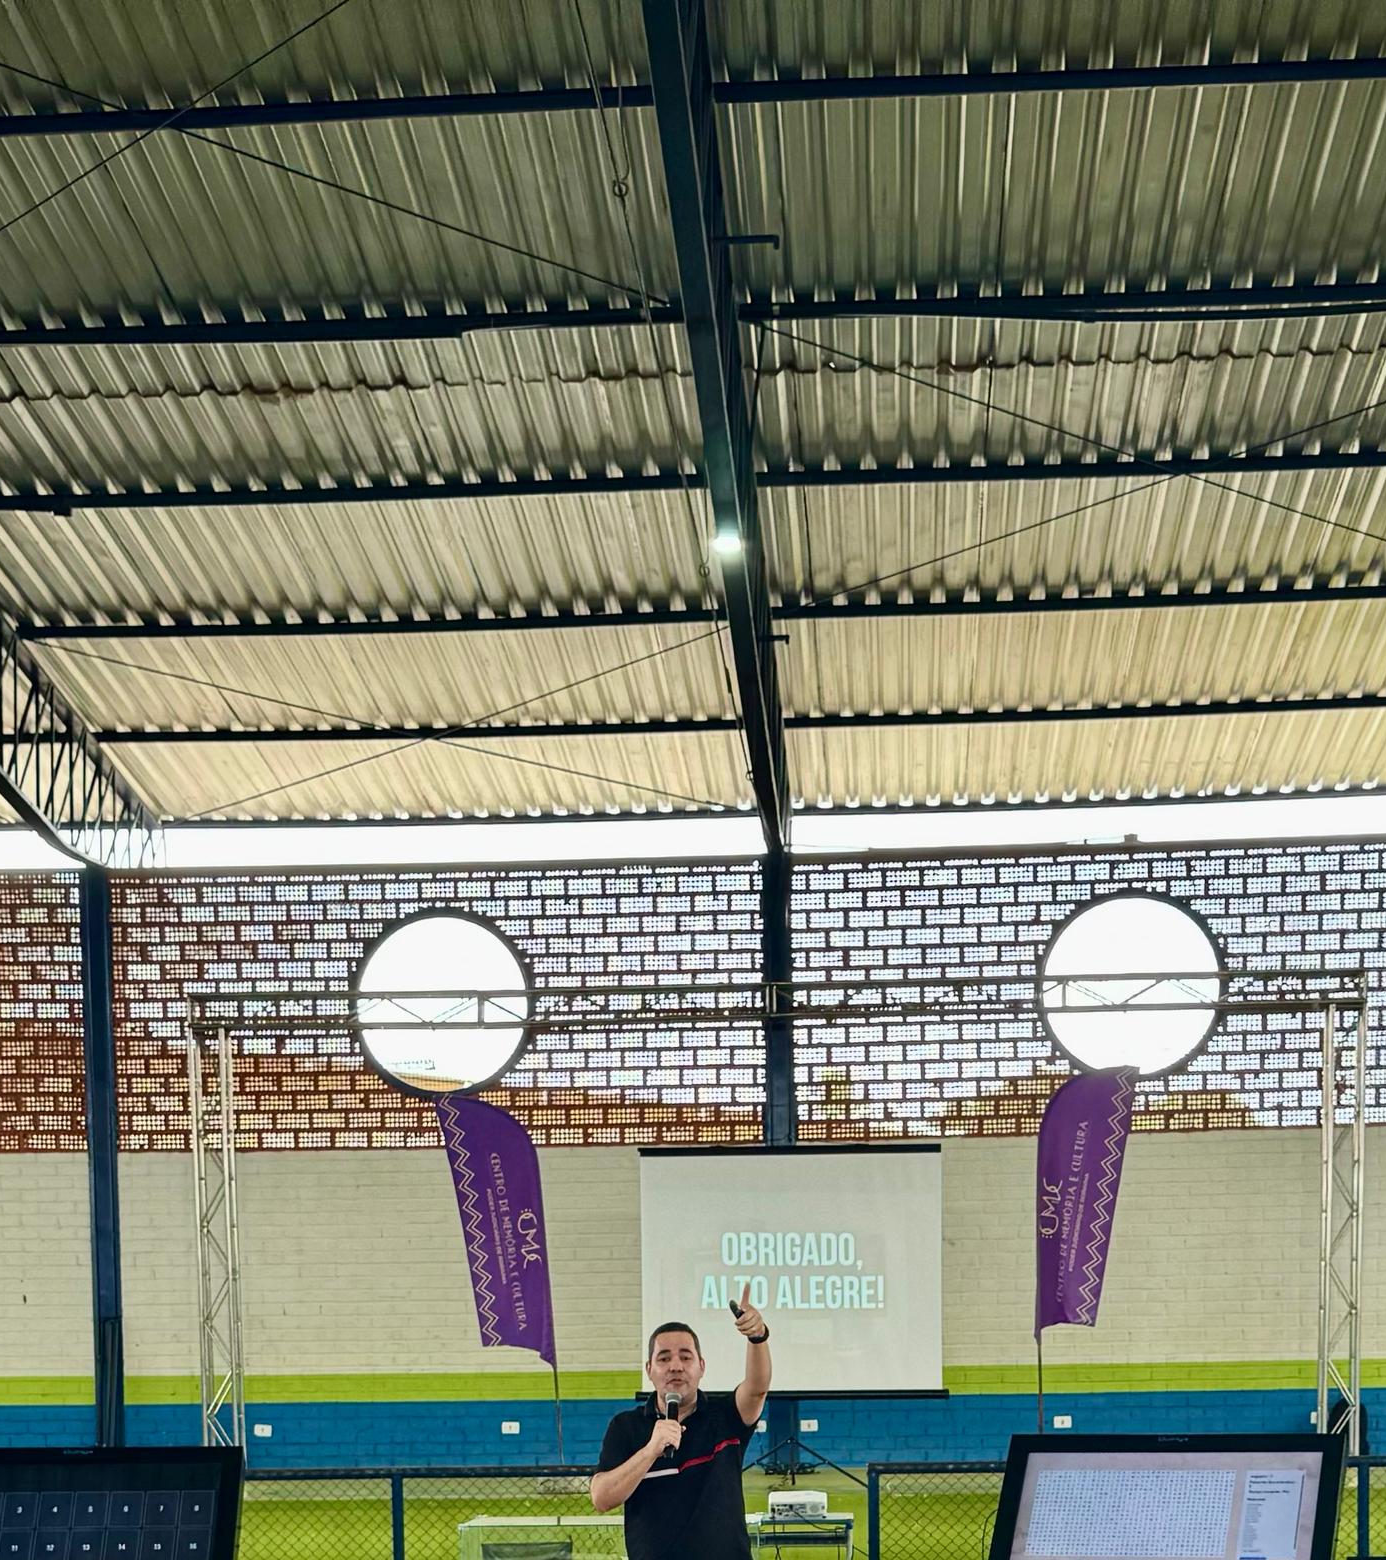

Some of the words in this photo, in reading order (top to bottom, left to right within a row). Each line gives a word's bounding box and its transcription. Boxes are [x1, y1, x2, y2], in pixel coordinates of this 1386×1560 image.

[1071, 1121, 1089, 1172] CULTURA
[489, 1153, 507, 1195] CENTRO
[499, 1198, 511, 1213] DE
[501, 1216, 519, 1268] MEMÓRIA
[721, 1232, 863, 1270] OBRIGADO,
[511, 1281, 528, 1331] CULTURA
[701, 1275, 768, 1309] ALTO
[776, 1275, 884, 1309] ALEGRE!
